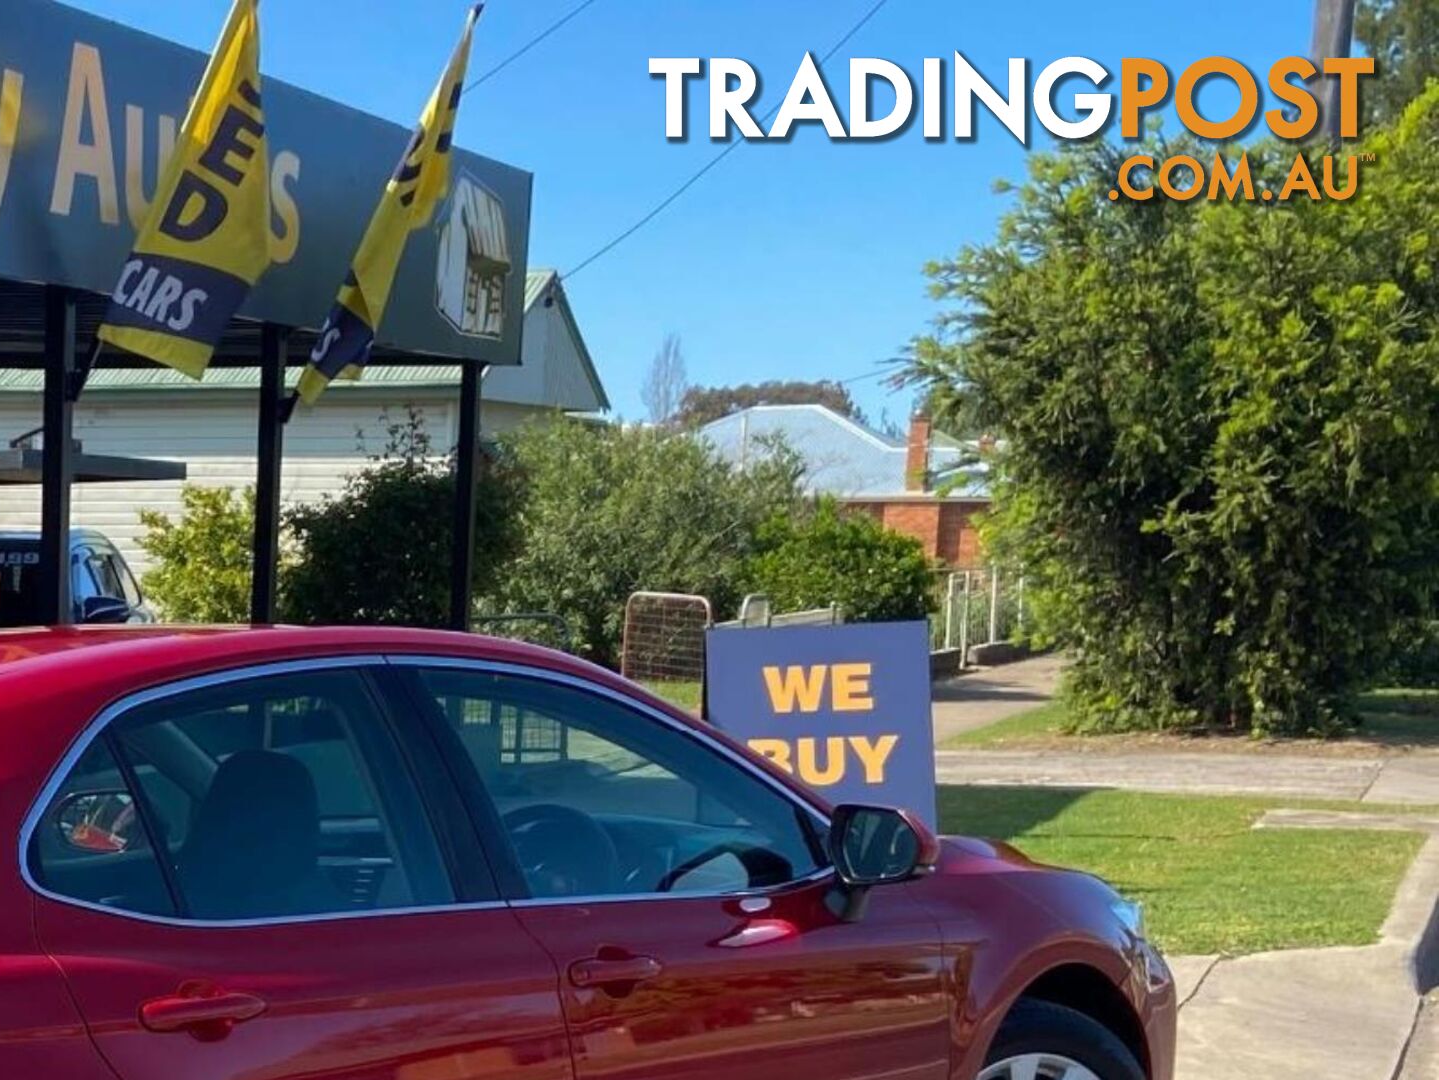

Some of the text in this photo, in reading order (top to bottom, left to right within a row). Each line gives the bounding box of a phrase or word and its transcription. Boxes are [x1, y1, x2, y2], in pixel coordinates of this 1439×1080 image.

[50, 41, 300, 264] Aus
[112, 257, 210, 332] CARS
[763, 662, 875, 714] WE
[747, 734, 899, 786] BUY
